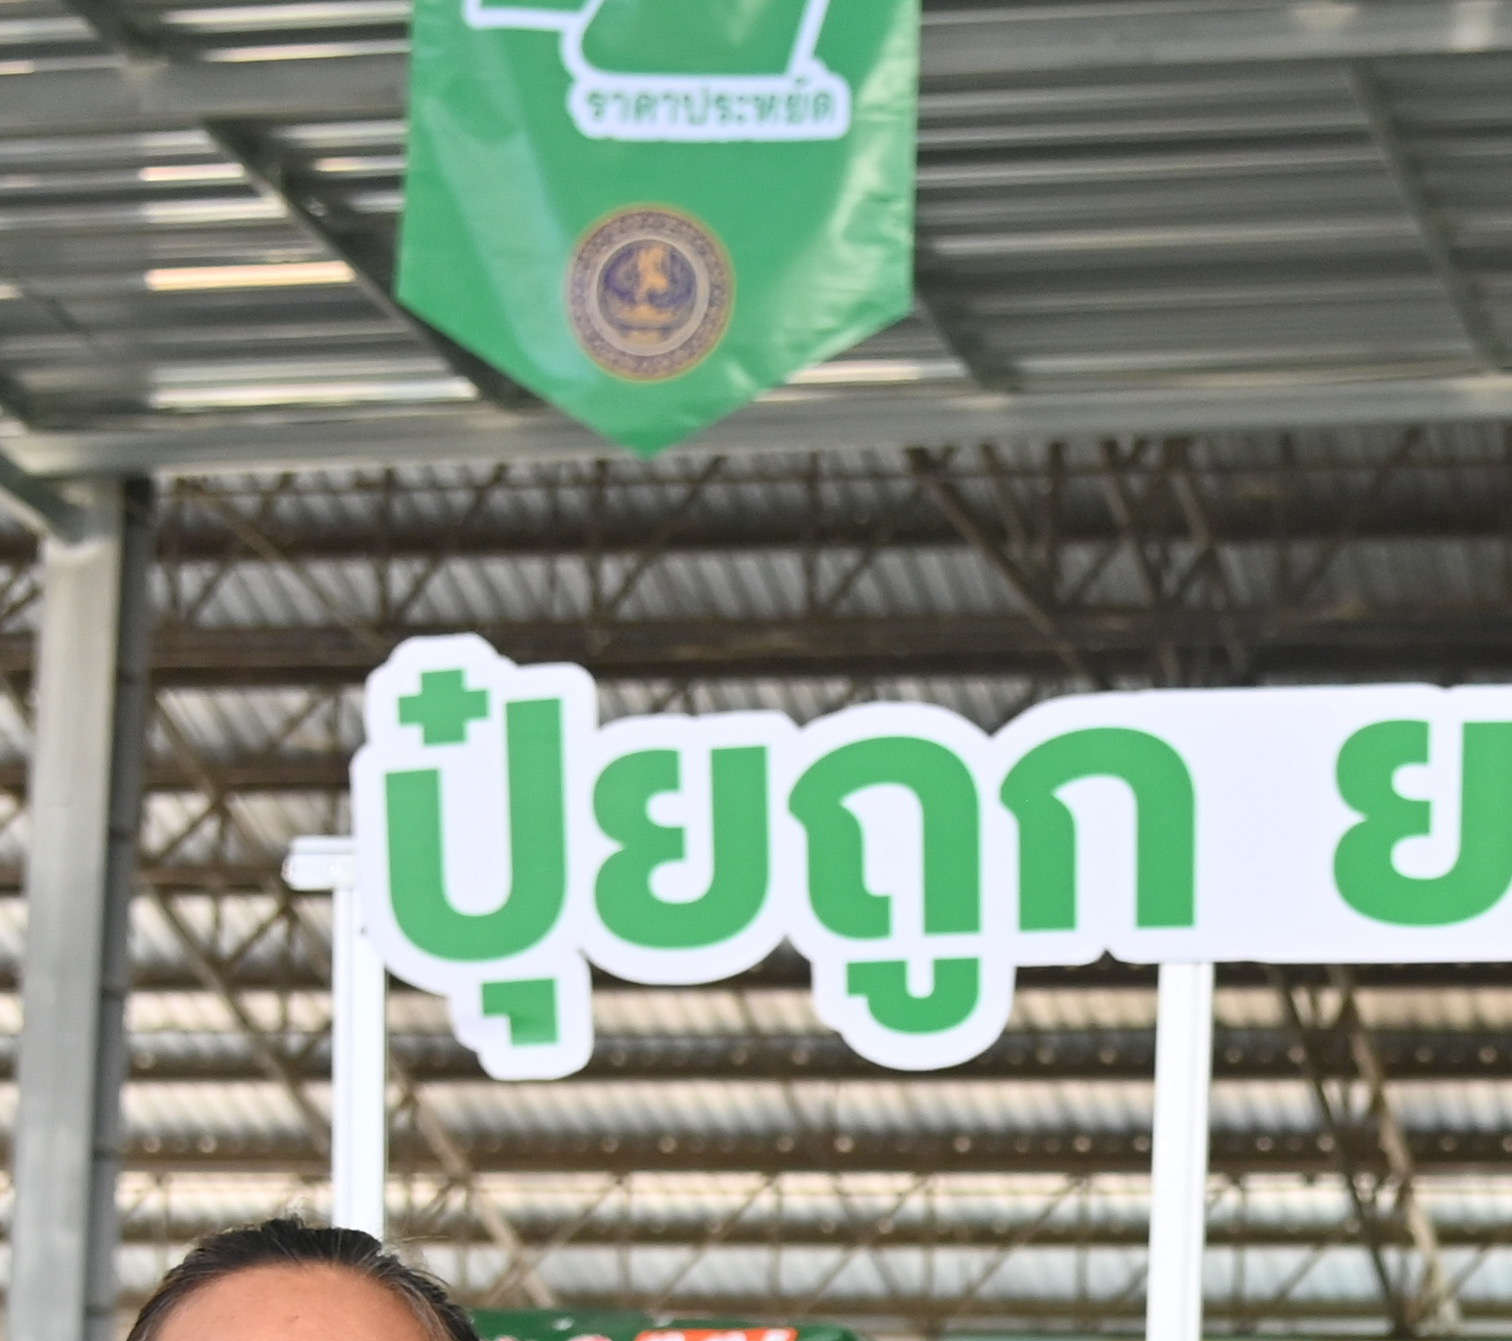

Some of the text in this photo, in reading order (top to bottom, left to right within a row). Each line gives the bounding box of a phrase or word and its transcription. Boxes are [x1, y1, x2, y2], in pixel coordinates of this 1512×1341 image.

[587, 78, 841, 126] ราคาประหยัด
[384, 669, 1195, 1048] ปุ๋ยถูก
